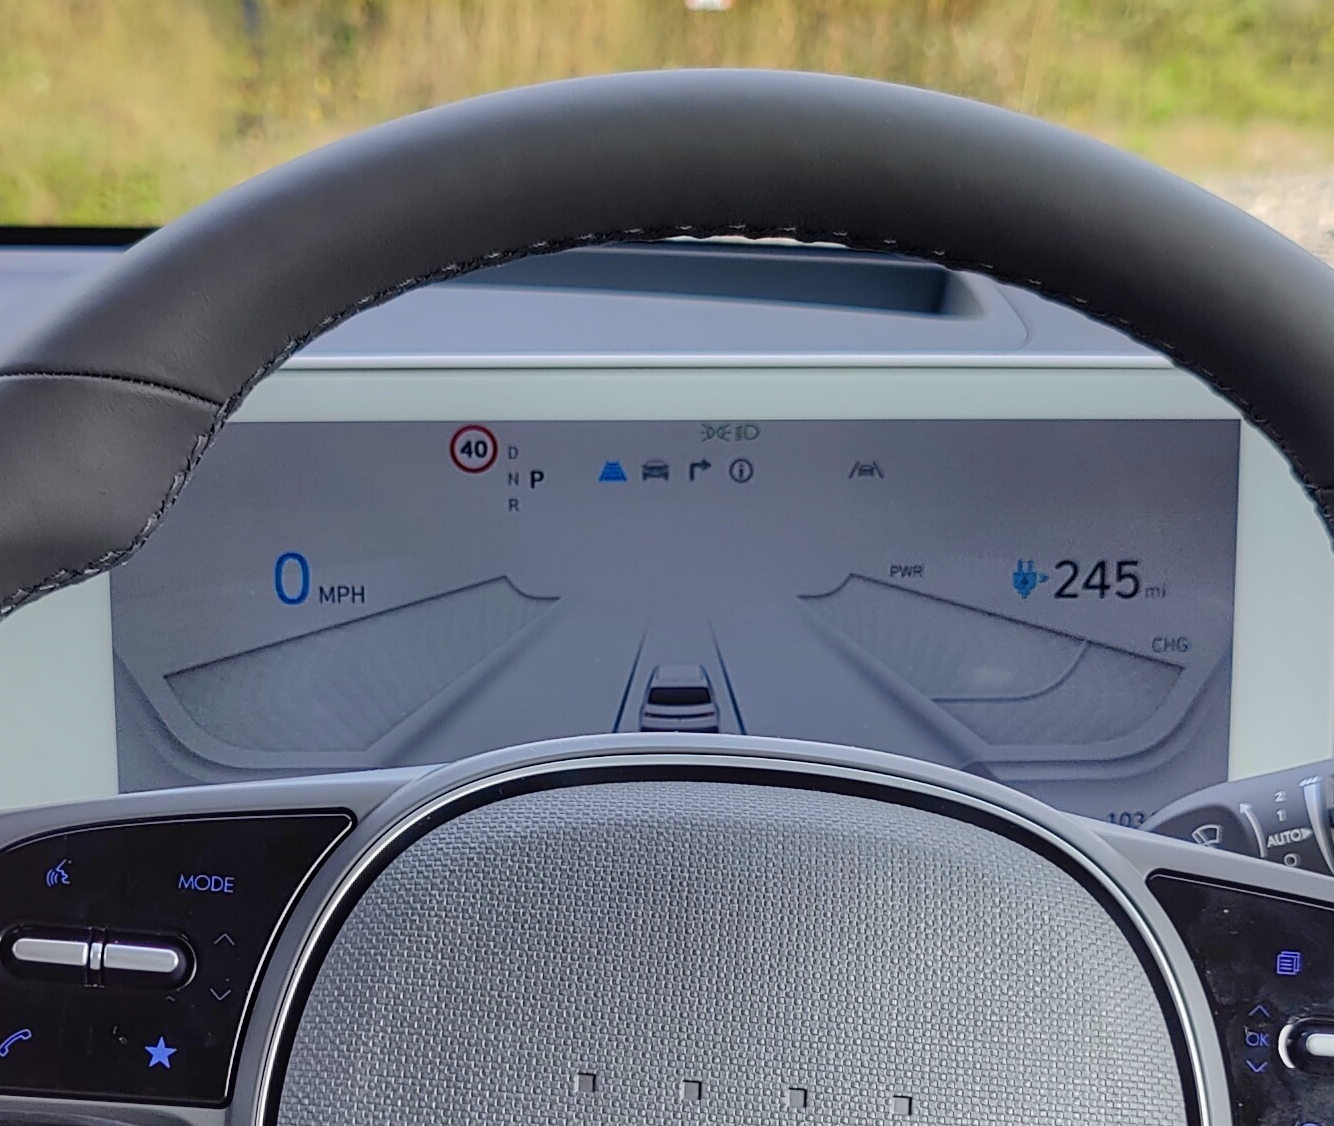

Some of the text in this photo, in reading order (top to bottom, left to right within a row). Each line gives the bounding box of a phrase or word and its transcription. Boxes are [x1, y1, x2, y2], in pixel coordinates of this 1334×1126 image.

[460, 440, 489, 459] 40
[508, 446, 519, 460] D
[508, 473, 519, 487] N
[530, 470, 545, 490] P
[508, 499, 520, 513] R
[274, 551, 366, 606] 0 MPH
[889, 563, 925, 580] PWR
[1053, 559, 1141, 600] 245
[1151, 636, 1190, 654] CHG
[1273, 791, 1286, 803] 2
[1266, 828, 1303, 849] AUTO
[178, 873, 236, 894] MODE
[1245, 1031, 1270, 1048] OK
